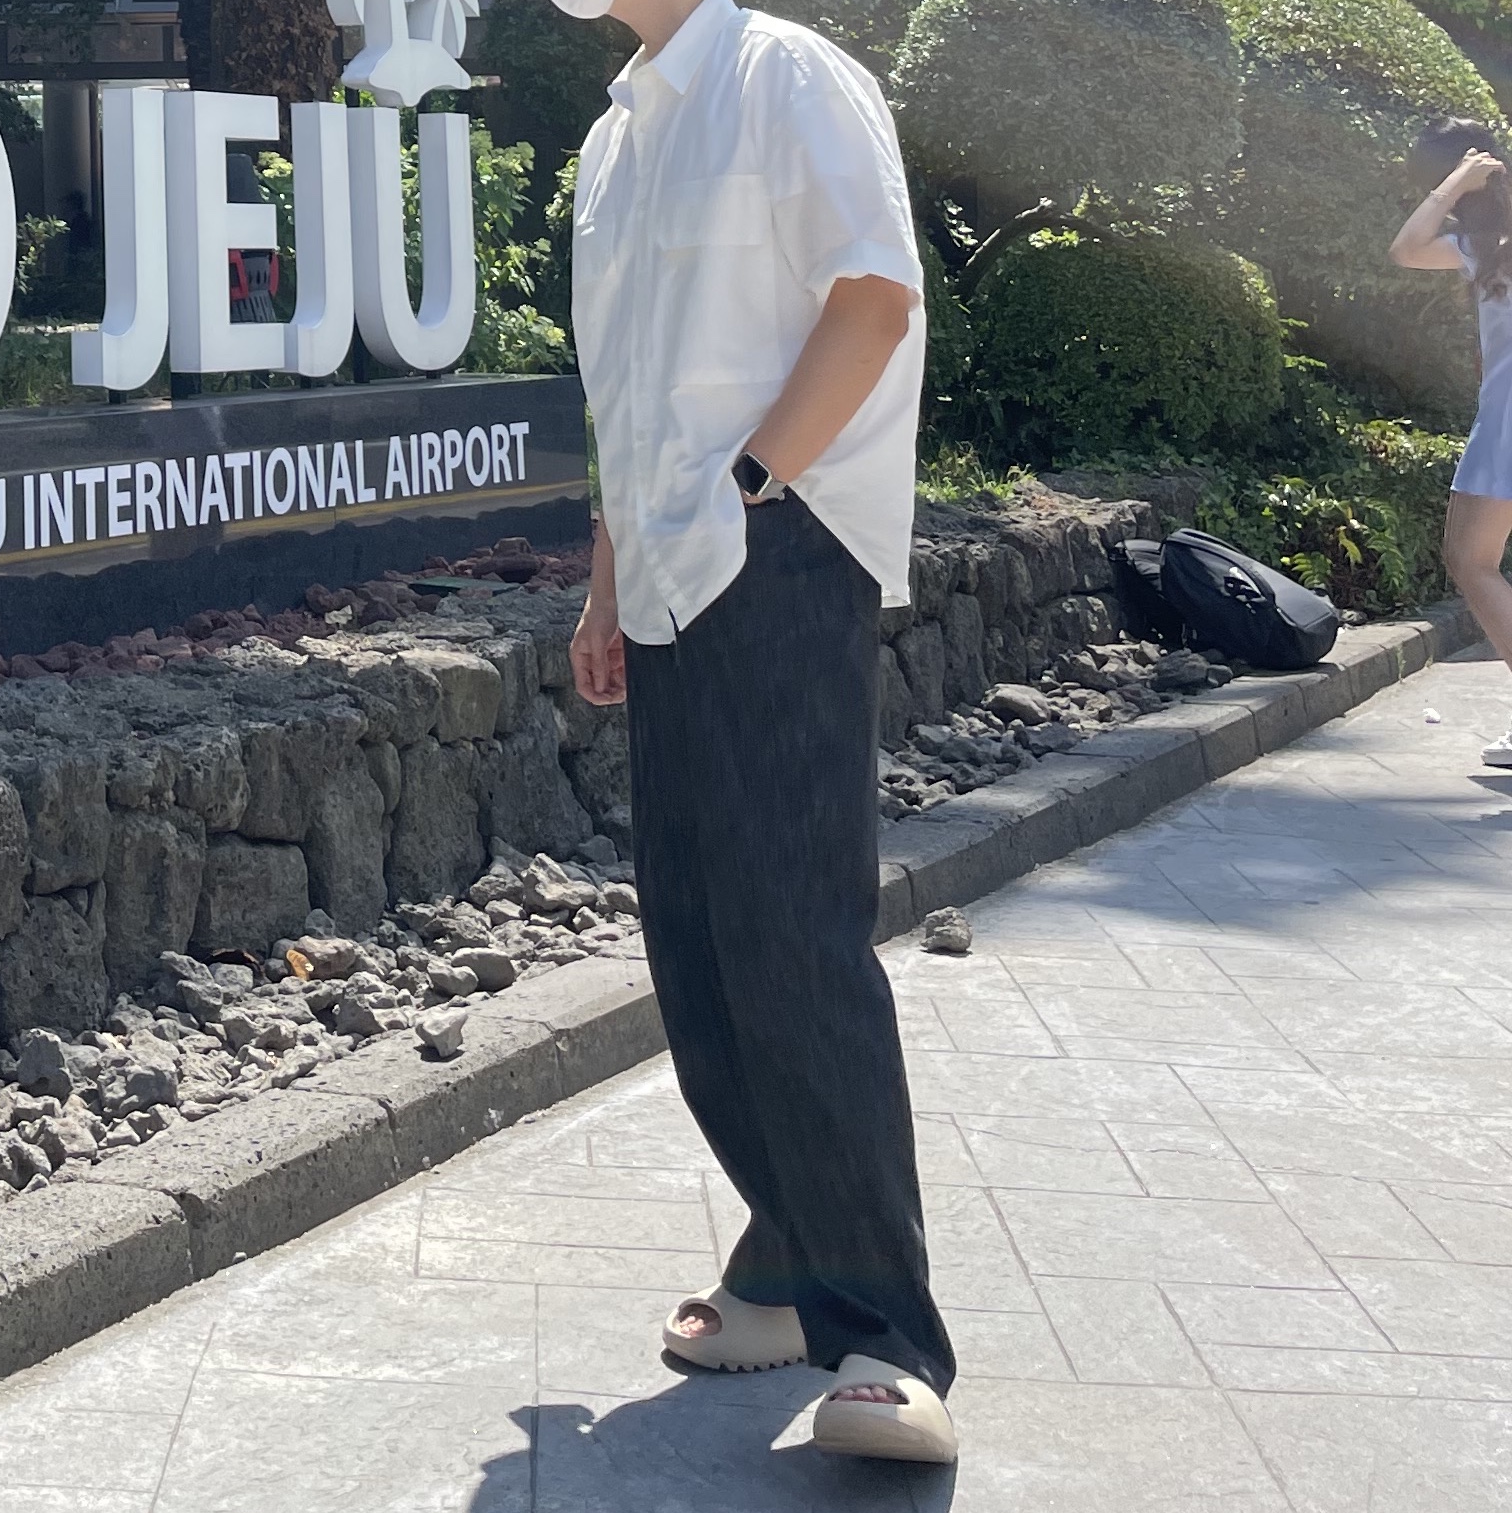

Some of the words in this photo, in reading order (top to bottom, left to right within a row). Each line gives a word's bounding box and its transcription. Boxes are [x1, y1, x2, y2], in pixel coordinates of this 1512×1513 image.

[71, 87, 475, 391] JEJU
[23, 439, 377, 550] INTERNATIONAL
[384, 421, 530, 500] AIRPORT
